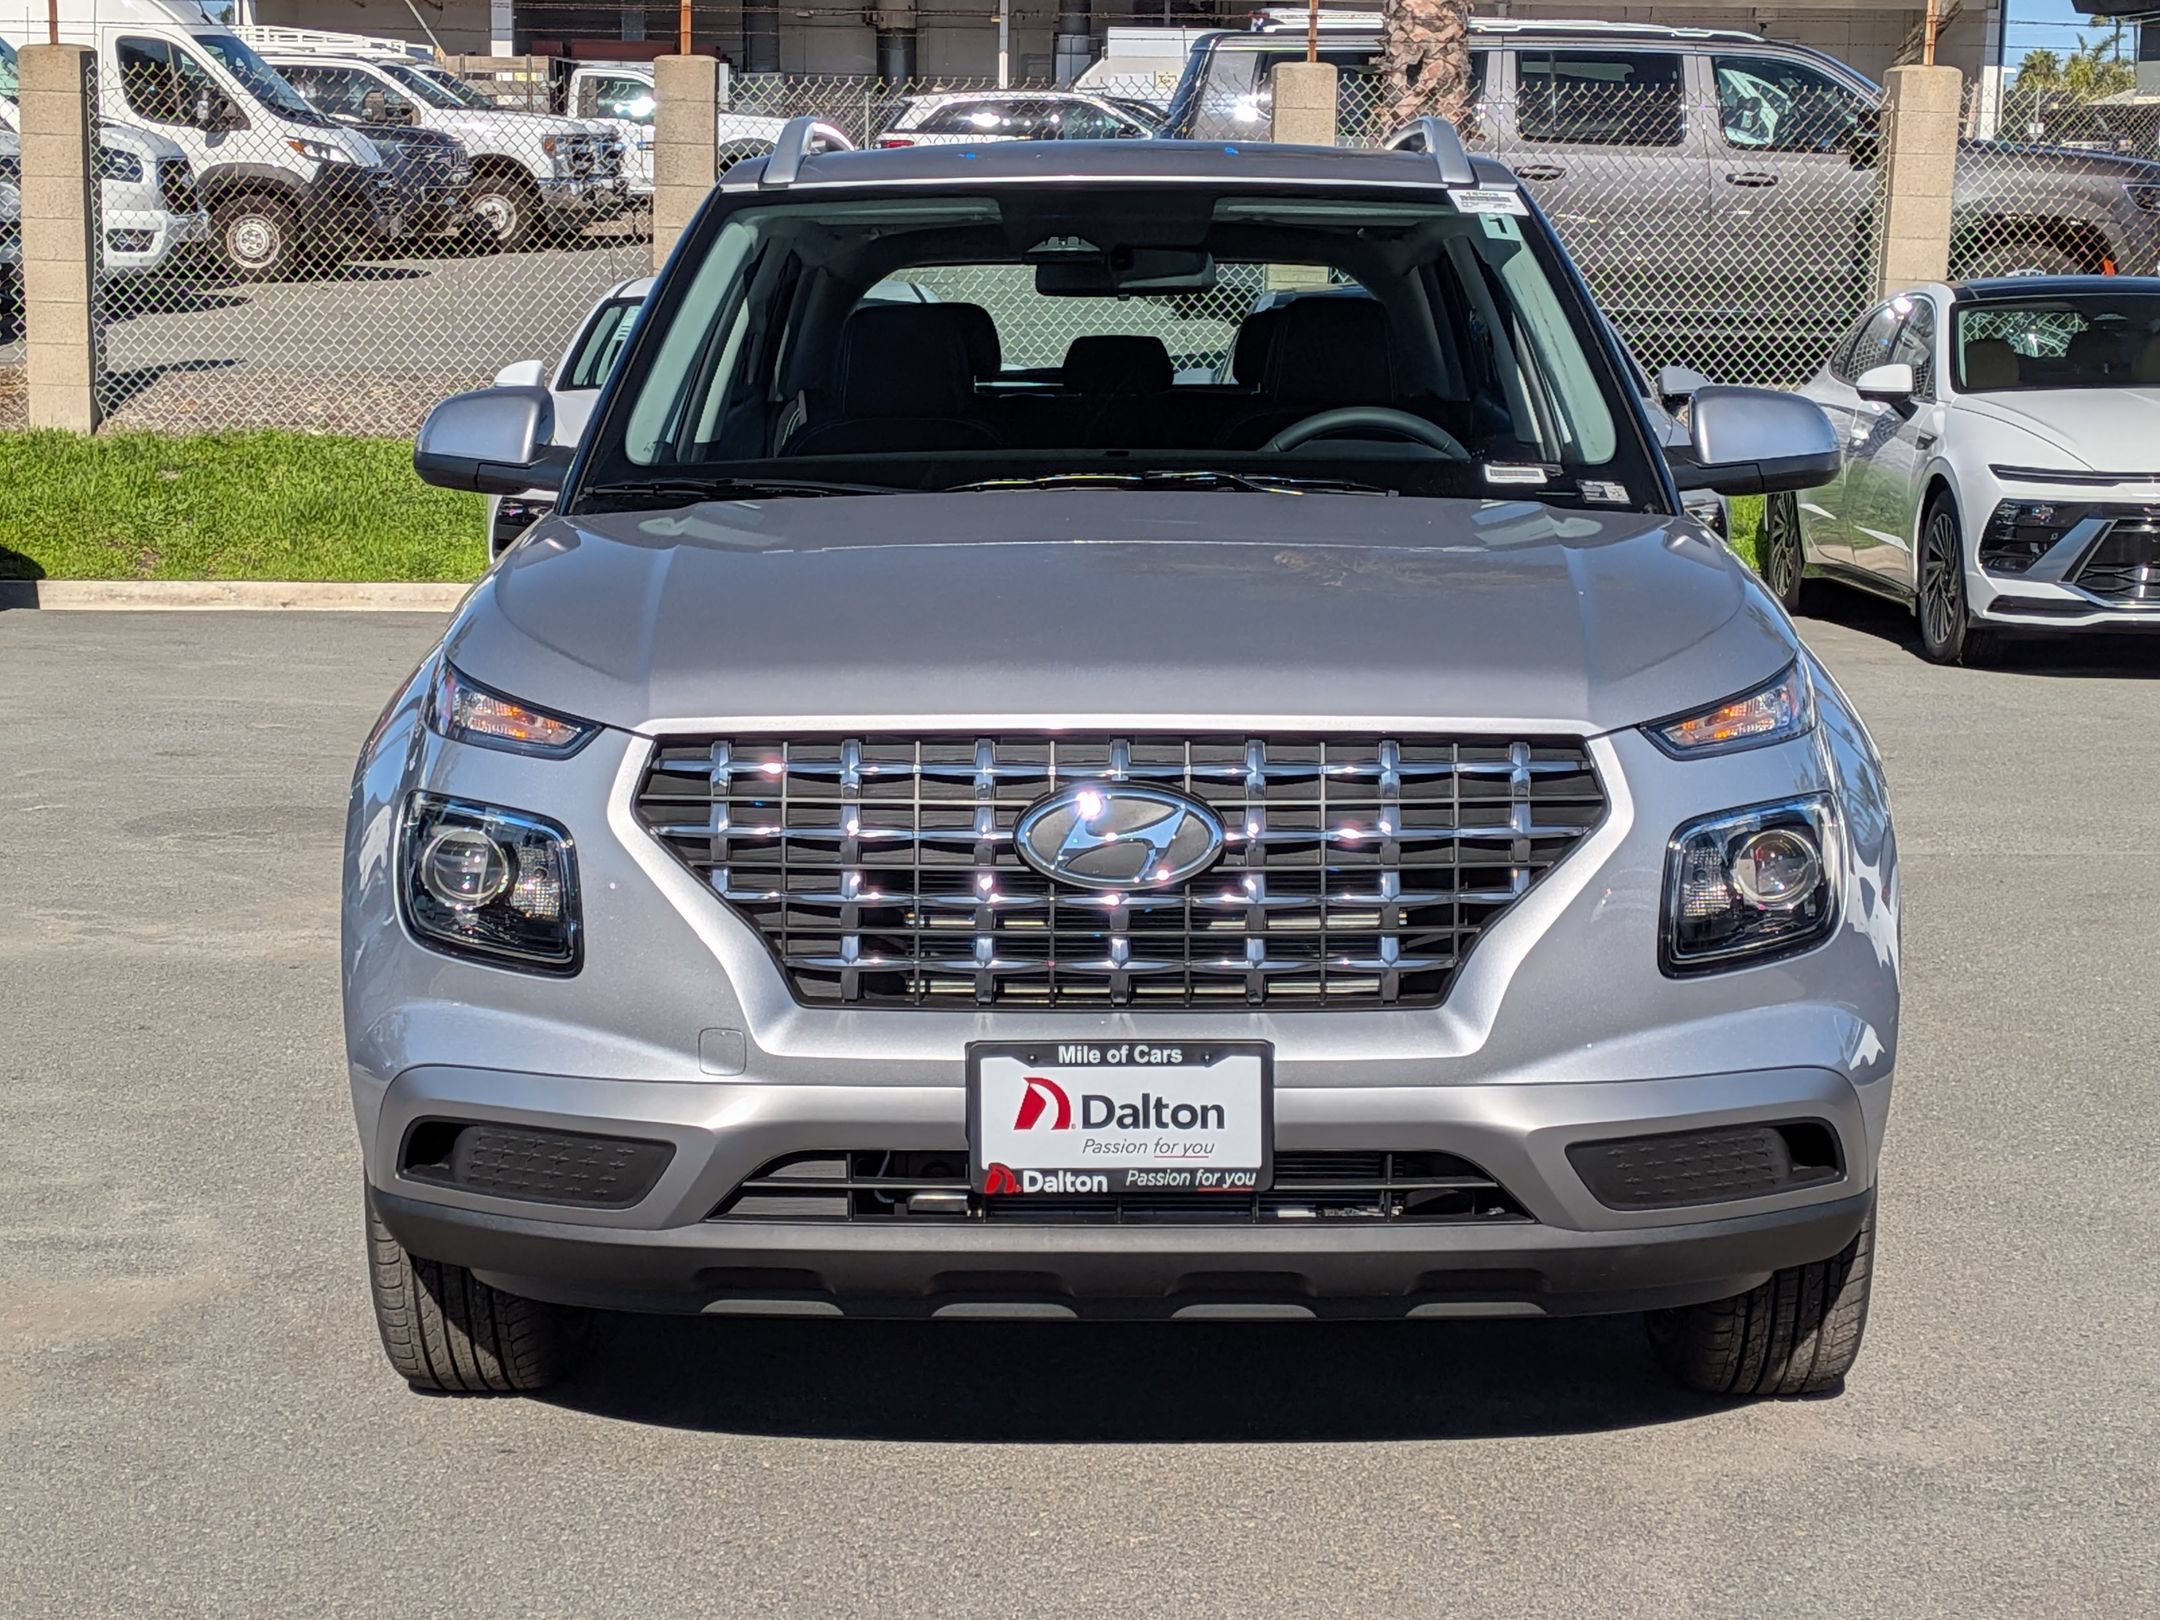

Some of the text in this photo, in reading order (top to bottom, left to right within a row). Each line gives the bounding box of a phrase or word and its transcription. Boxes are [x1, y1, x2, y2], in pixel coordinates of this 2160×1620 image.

[1058, 1045, 1183, 1063] Mile of Cars
[1081, 1093, 1225, 1130] Dalton
[1082, 1137, 1215, 1157] Passion for you
[1022, 1170, 1108, 1193] Dalton
[1125, 1169, 1257, 1189] Passion for you
